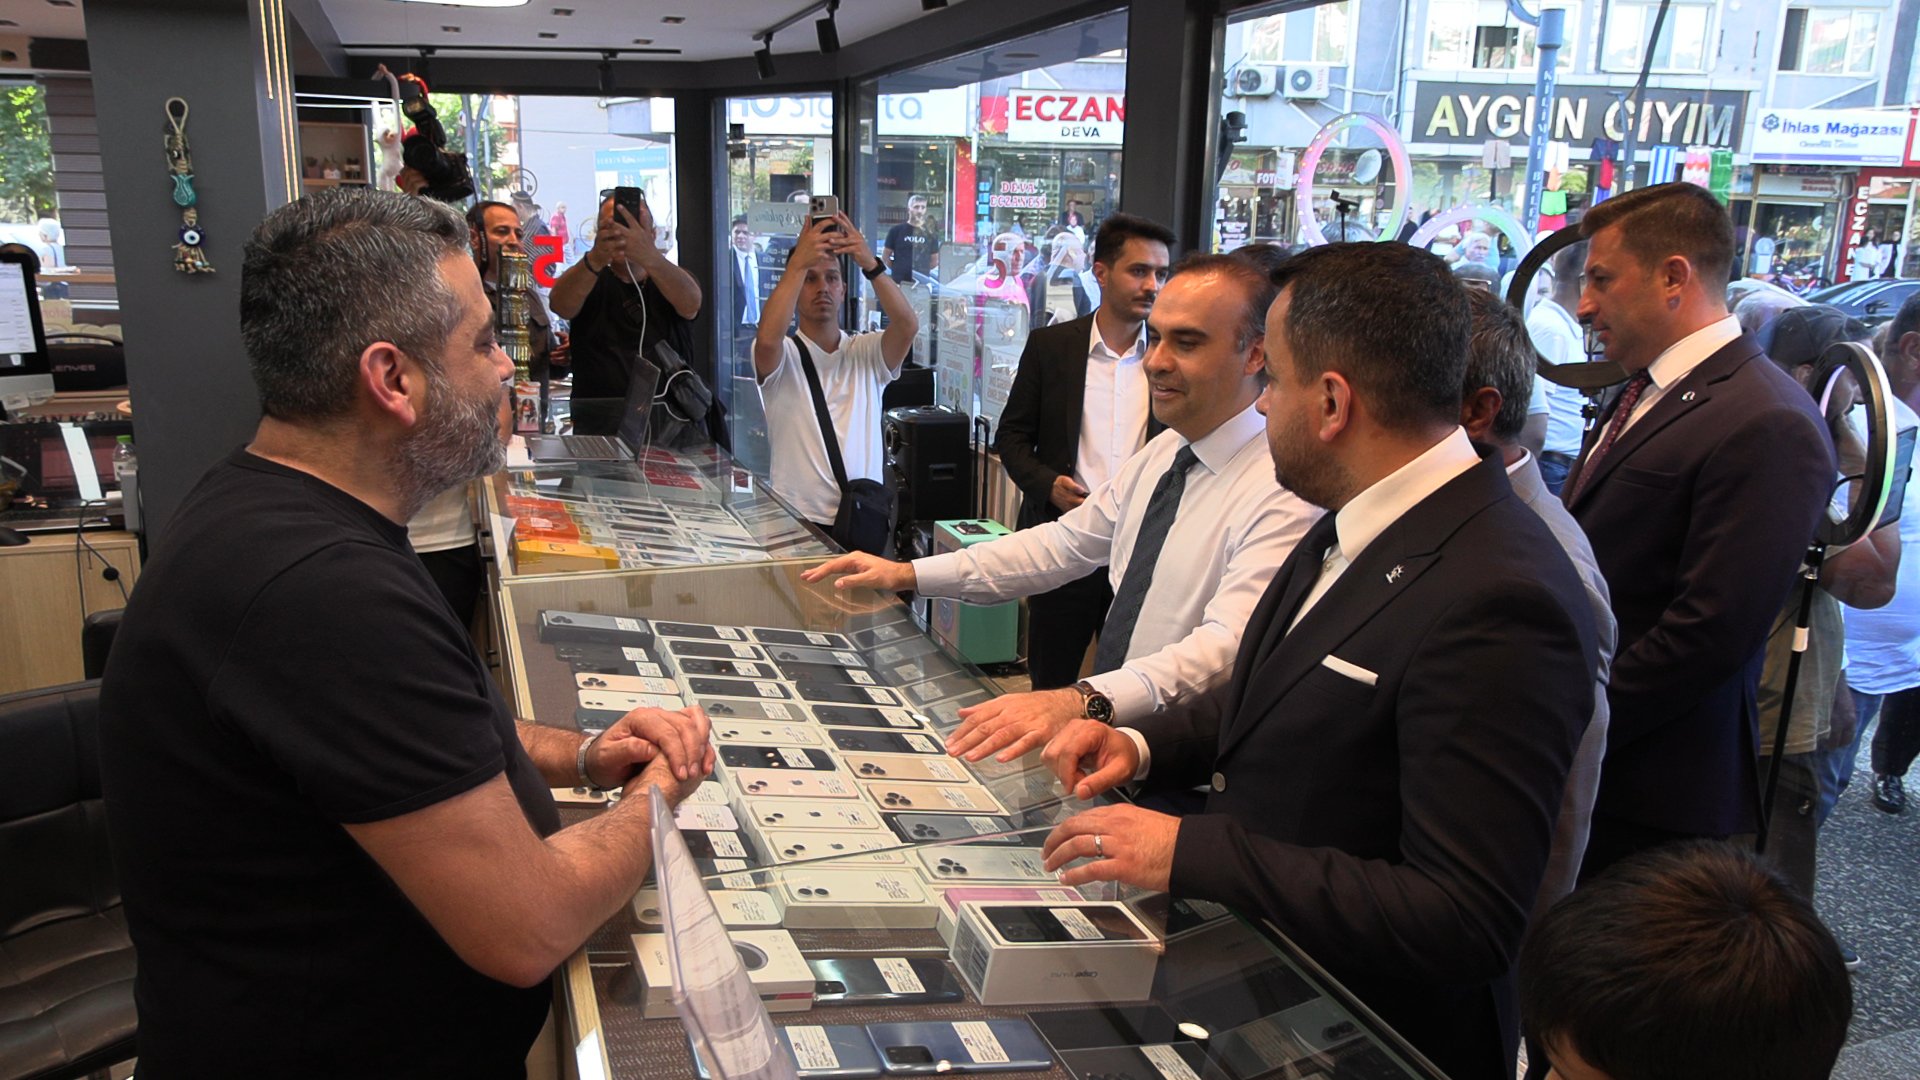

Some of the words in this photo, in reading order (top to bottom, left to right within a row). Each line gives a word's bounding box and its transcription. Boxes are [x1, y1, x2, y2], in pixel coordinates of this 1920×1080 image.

[1061, 126, 1100, 138] DEVA
[1001, 181, 1036, 193] DEVA
[1844, 186, 1870, 276] ECZANE
